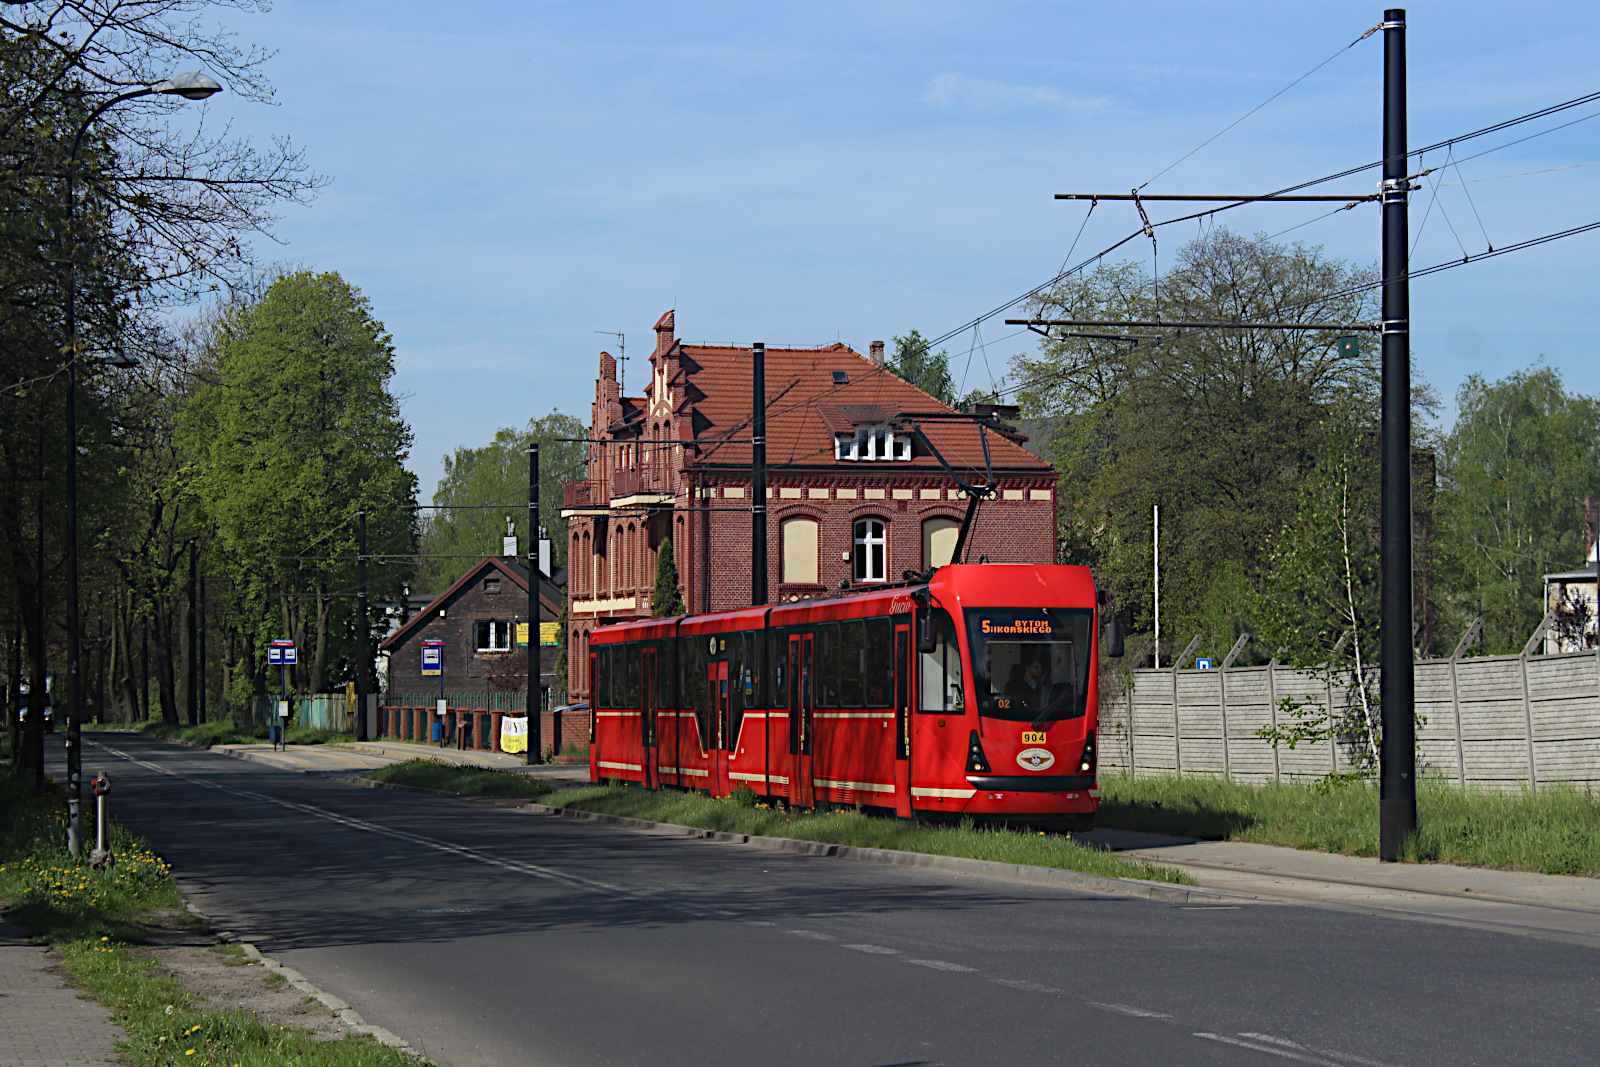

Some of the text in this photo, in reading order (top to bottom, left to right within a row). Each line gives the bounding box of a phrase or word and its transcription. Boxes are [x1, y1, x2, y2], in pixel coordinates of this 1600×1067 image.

[889, 593, 912, 615] Gucio
[982, 619, 991, 634] 5
[1015, 619, 1049, 627] BYTOM
[998, 698, 1011, 709] 02
[1024, 733, 1045, 742] 904
